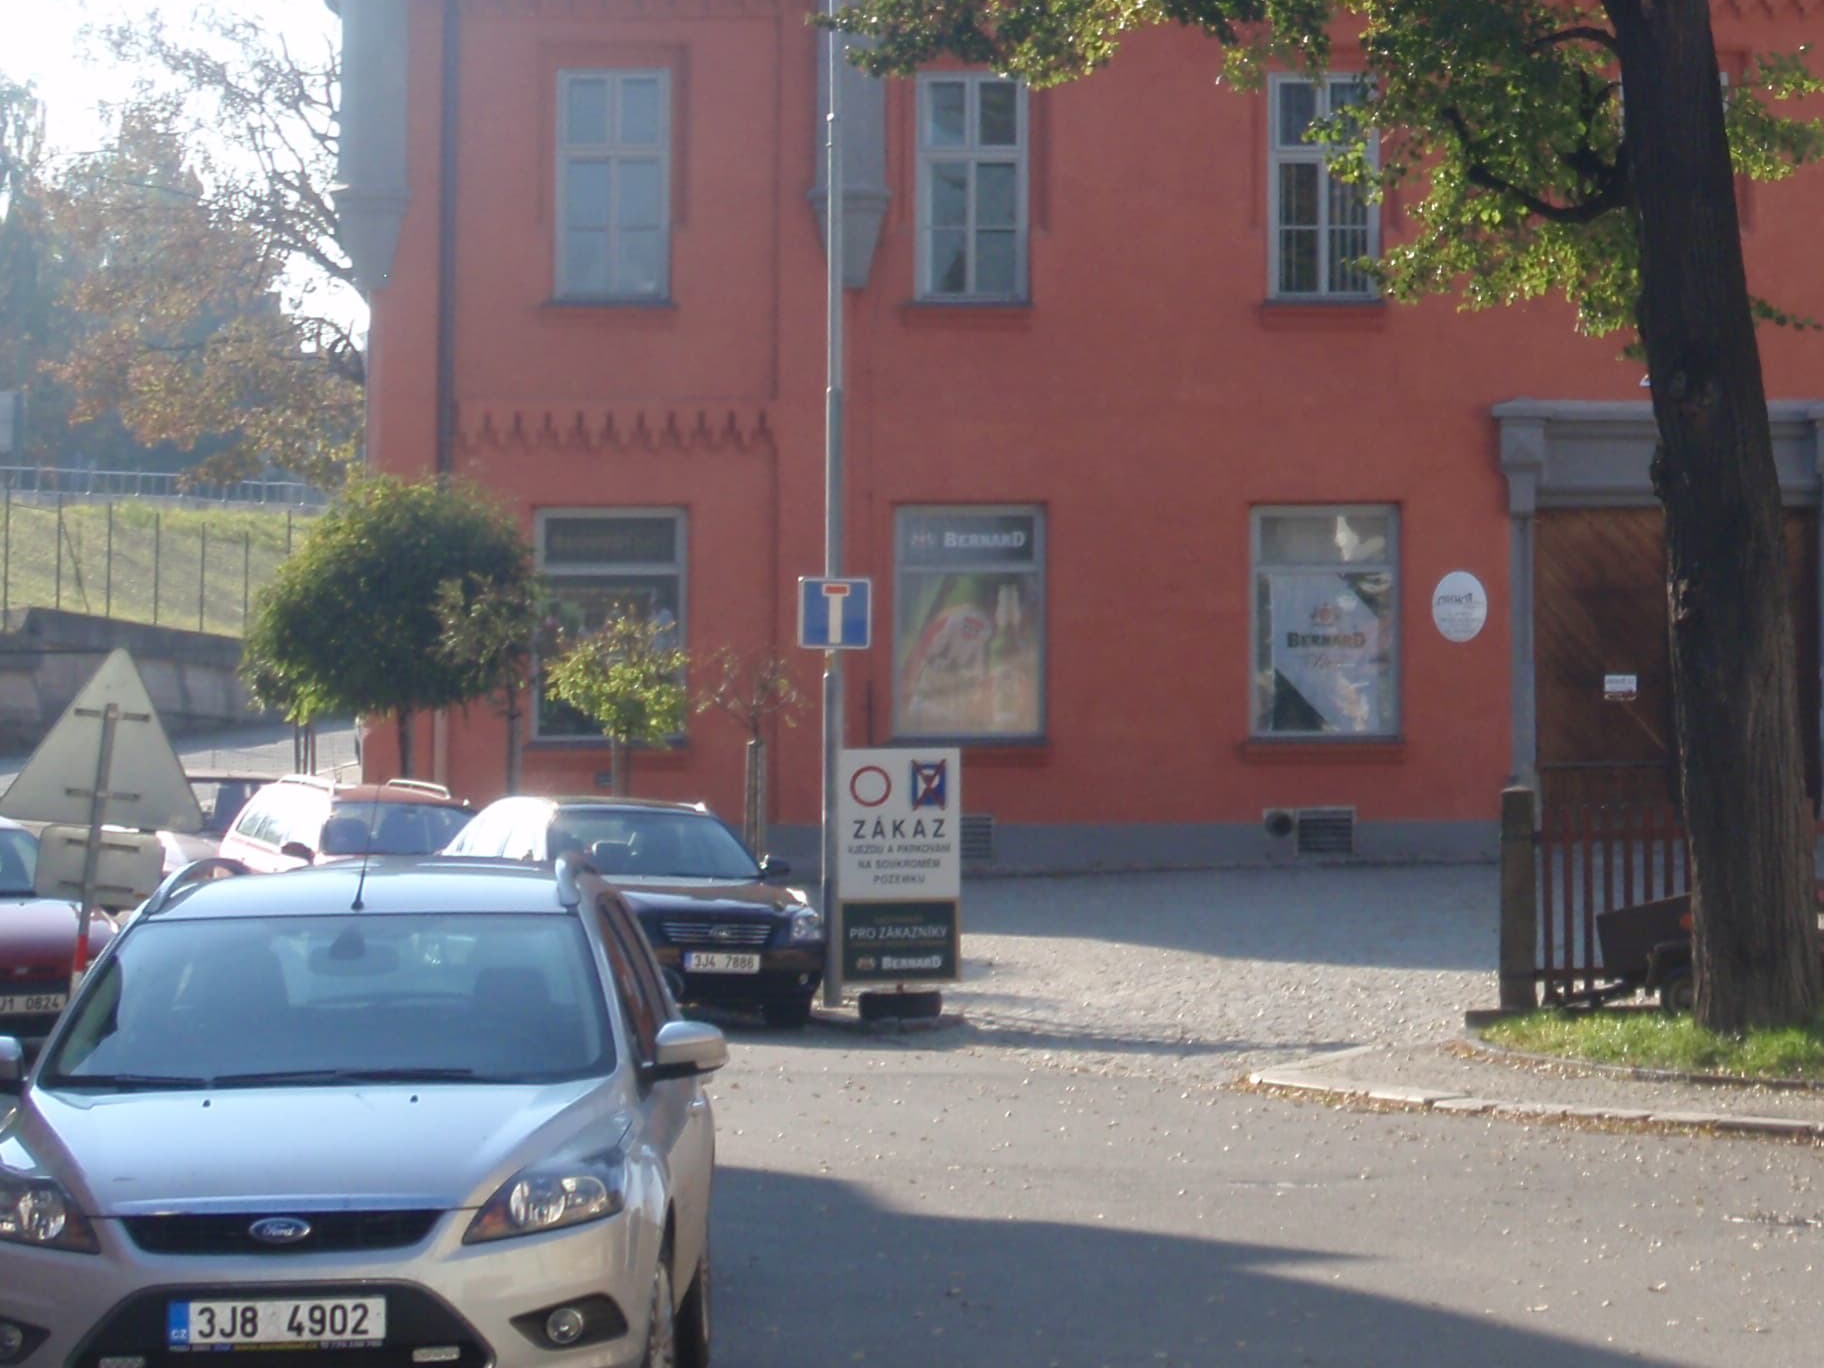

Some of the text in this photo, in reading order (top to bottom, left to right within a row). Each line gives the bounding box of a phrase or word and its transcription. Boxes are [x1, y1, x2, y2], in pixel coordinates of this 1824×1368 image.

[853, 816, 945, 839] ZÁKAZ
[849, 927, 876, 939] PRO
[198, 1302, 370, 1339] 3J8 4902
